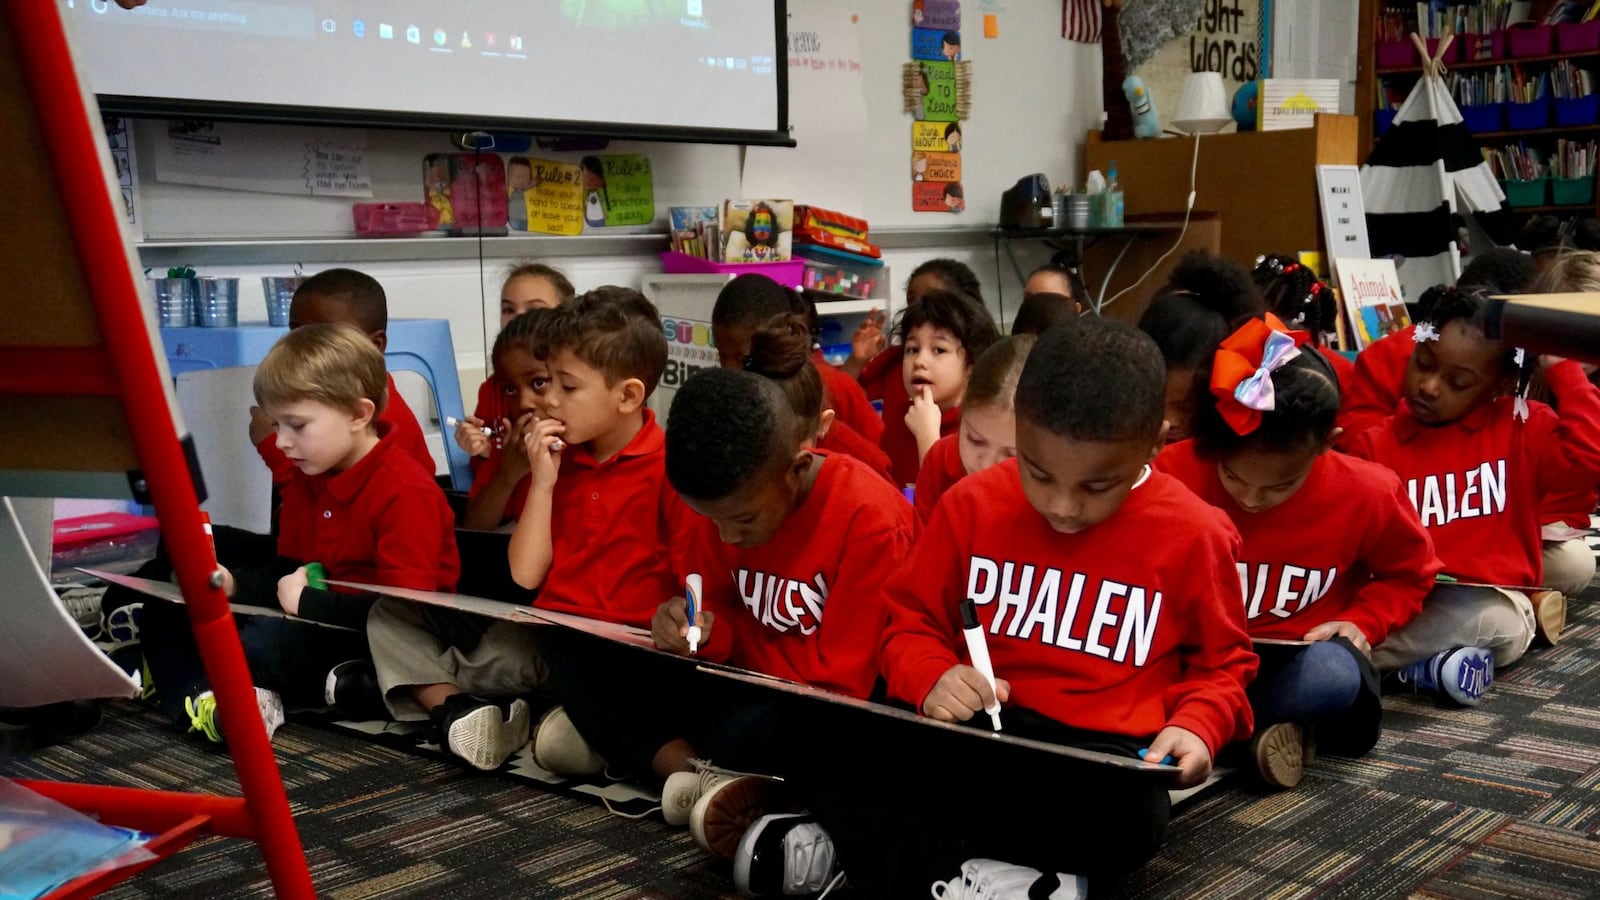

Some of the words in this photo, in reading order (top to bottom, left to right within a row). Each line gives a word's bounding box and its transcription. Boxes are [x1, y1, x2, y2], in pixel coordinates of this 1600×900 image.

[927, 65, 955, 80] Read
[937, 84, 951, 97] TO
[937, 137, 945, 147] IT
[929, 168, 955, 179] CHOICE
[1351, 272, 1389, 300] Animal
[1407, 459, 1506, 528] ALEN
[731, 568, 829, 636] HALEN
[966, 556, 1163, 667] PHALEN
